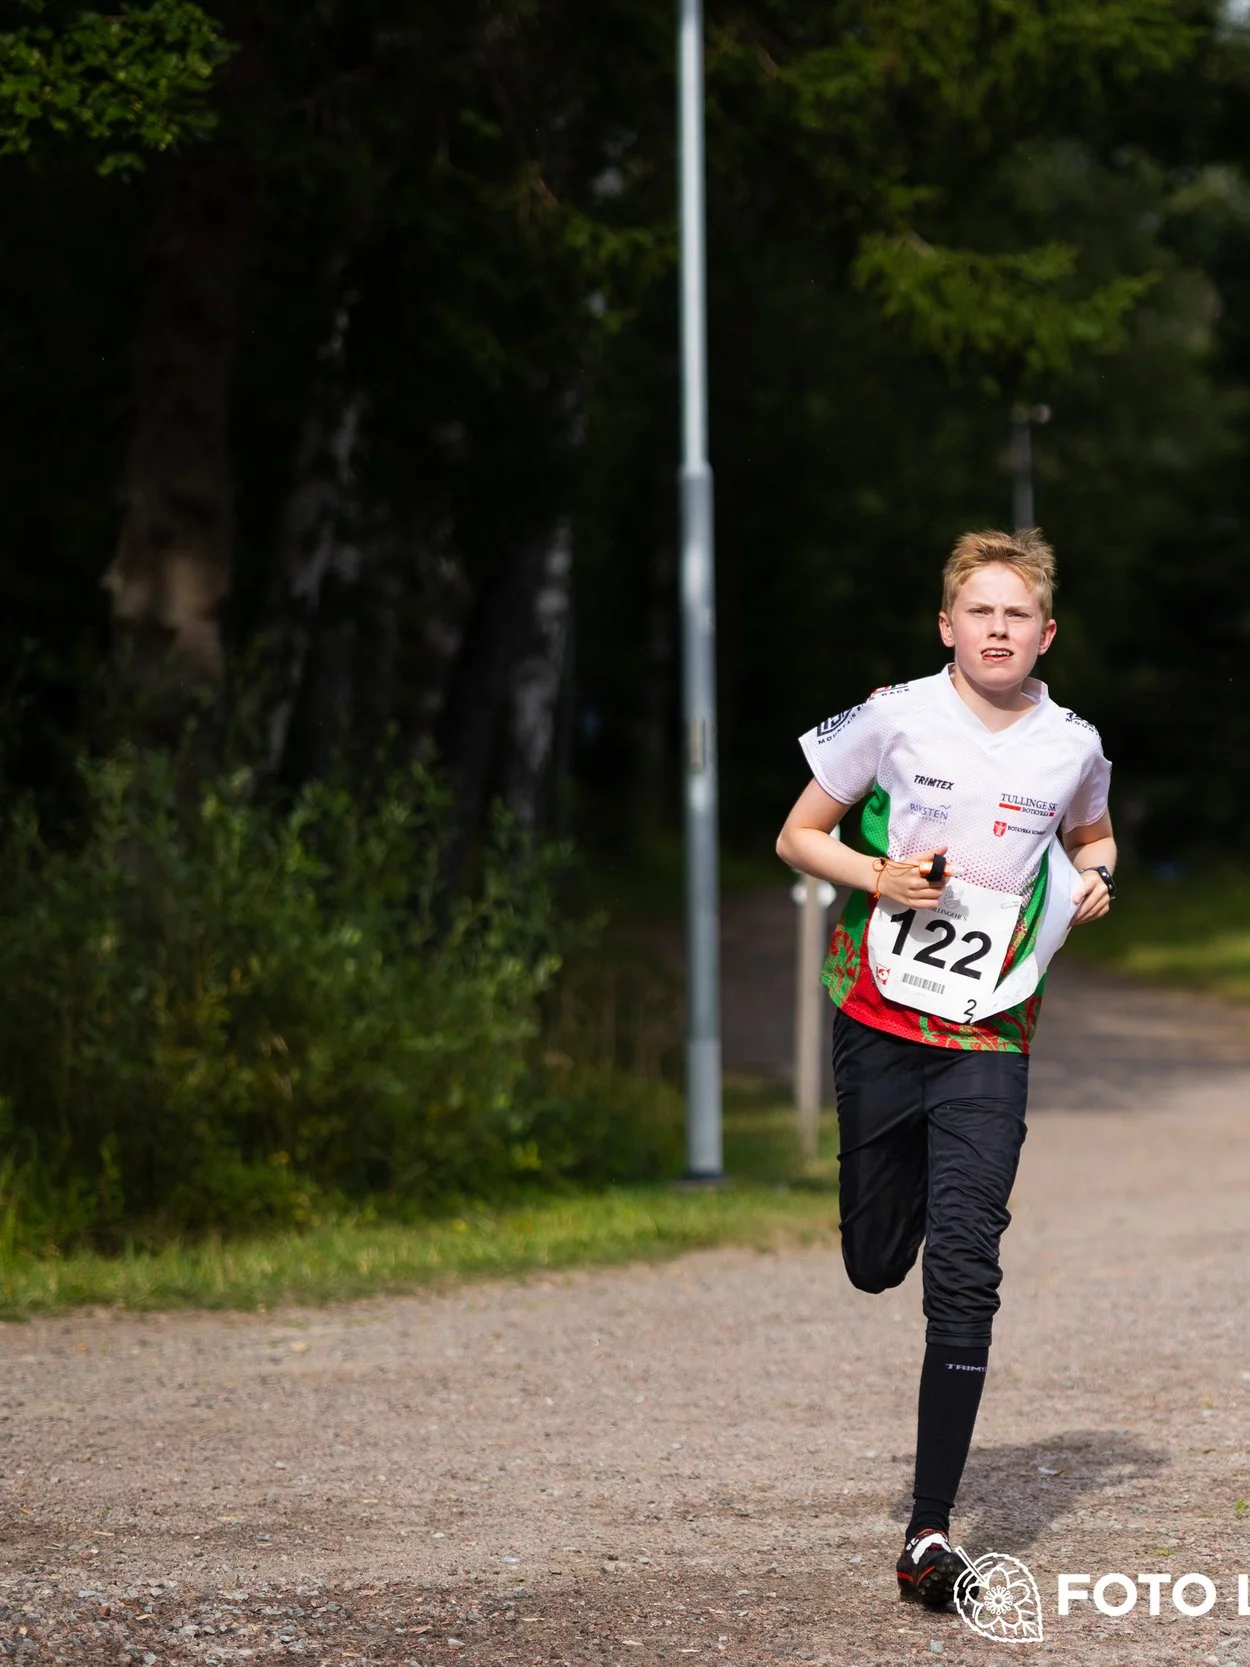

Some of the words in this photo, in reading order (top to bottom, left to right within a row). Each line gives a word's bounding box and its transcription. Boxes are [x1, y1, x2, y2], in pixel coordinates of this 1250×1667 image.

[914, 774, 955, 790] TRIMTEX
[1001, 793, 1048, 810] TULLINGE
[910, 803, 949, 820] RIKSTEN
[890, 908, 992, 981] 122
[963, 998, 978, 1018] 2
